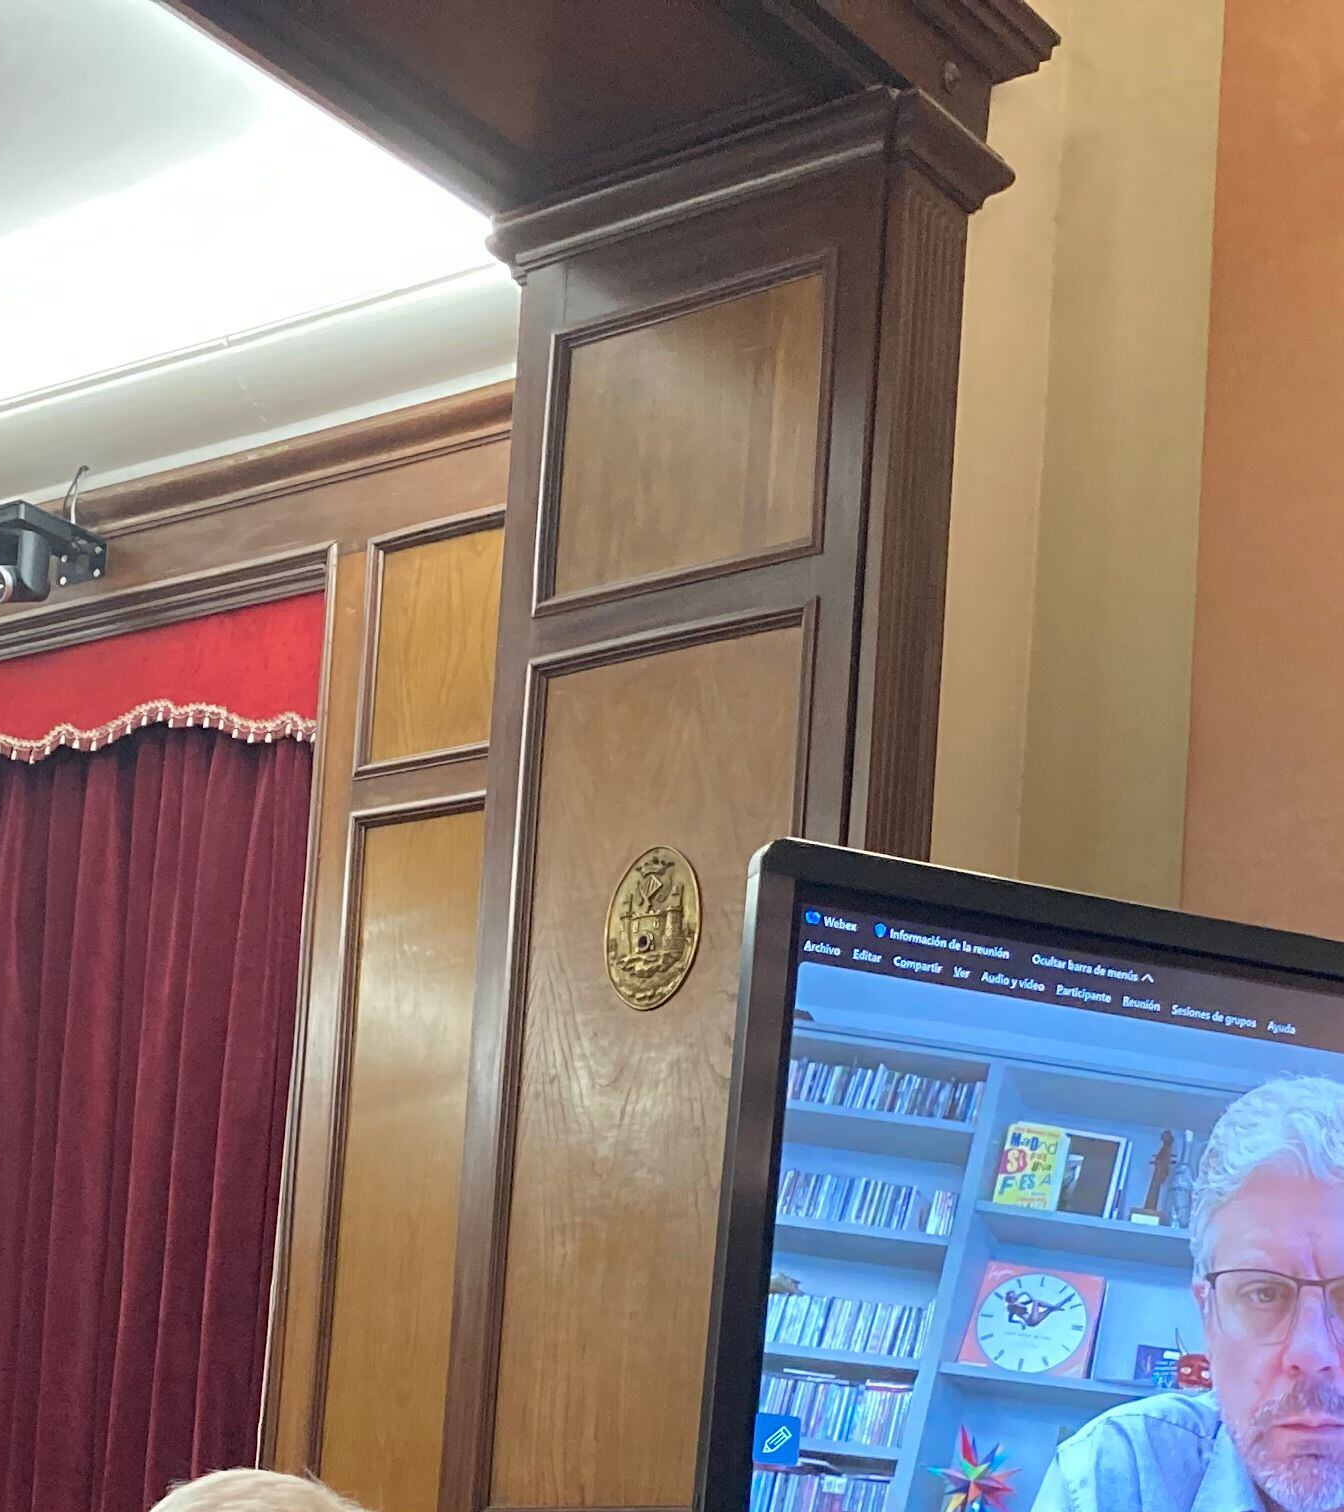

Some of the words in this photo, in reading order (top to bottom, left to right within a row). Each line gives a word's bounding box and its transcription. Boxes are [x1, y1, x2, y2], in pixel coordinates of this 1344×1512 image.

[824, 916, 858, 932] Webex
[804, 940, 841, 956] Archivo
[890, 928, 947, 948] Información
[948, 936, 961, 950] de
[963, 941, 972, 952] la
[973, 944, 1010, 959] reunión
[852, 949, 882, 964] Editar
[893, 956, 943, 975] Compartir
[953, 966, 971, 979] Ver
[1031, 953, 1065, 969] Ocultar
[1068, 960, 1092, 975] barra
[1094, 964, 1106, 977] de
[1107, 968, 1139, 982] menús
[981, 972, 1010, 986] Audio
[1010, 979, 1018, 990] y
[1018, 978, 1046, 993] vídeo
[1056, 984, 1112, 1003] Participante
[1122, 995, 1161, 1012] Reunión
[1172, 1004, 1211, 1021] Sesiones
[1212, 1010, 1224, 1023] de
[1225, 1014, 1257, 1030] grupos
[1267, 1020, 1296, 1036] Ayuda
